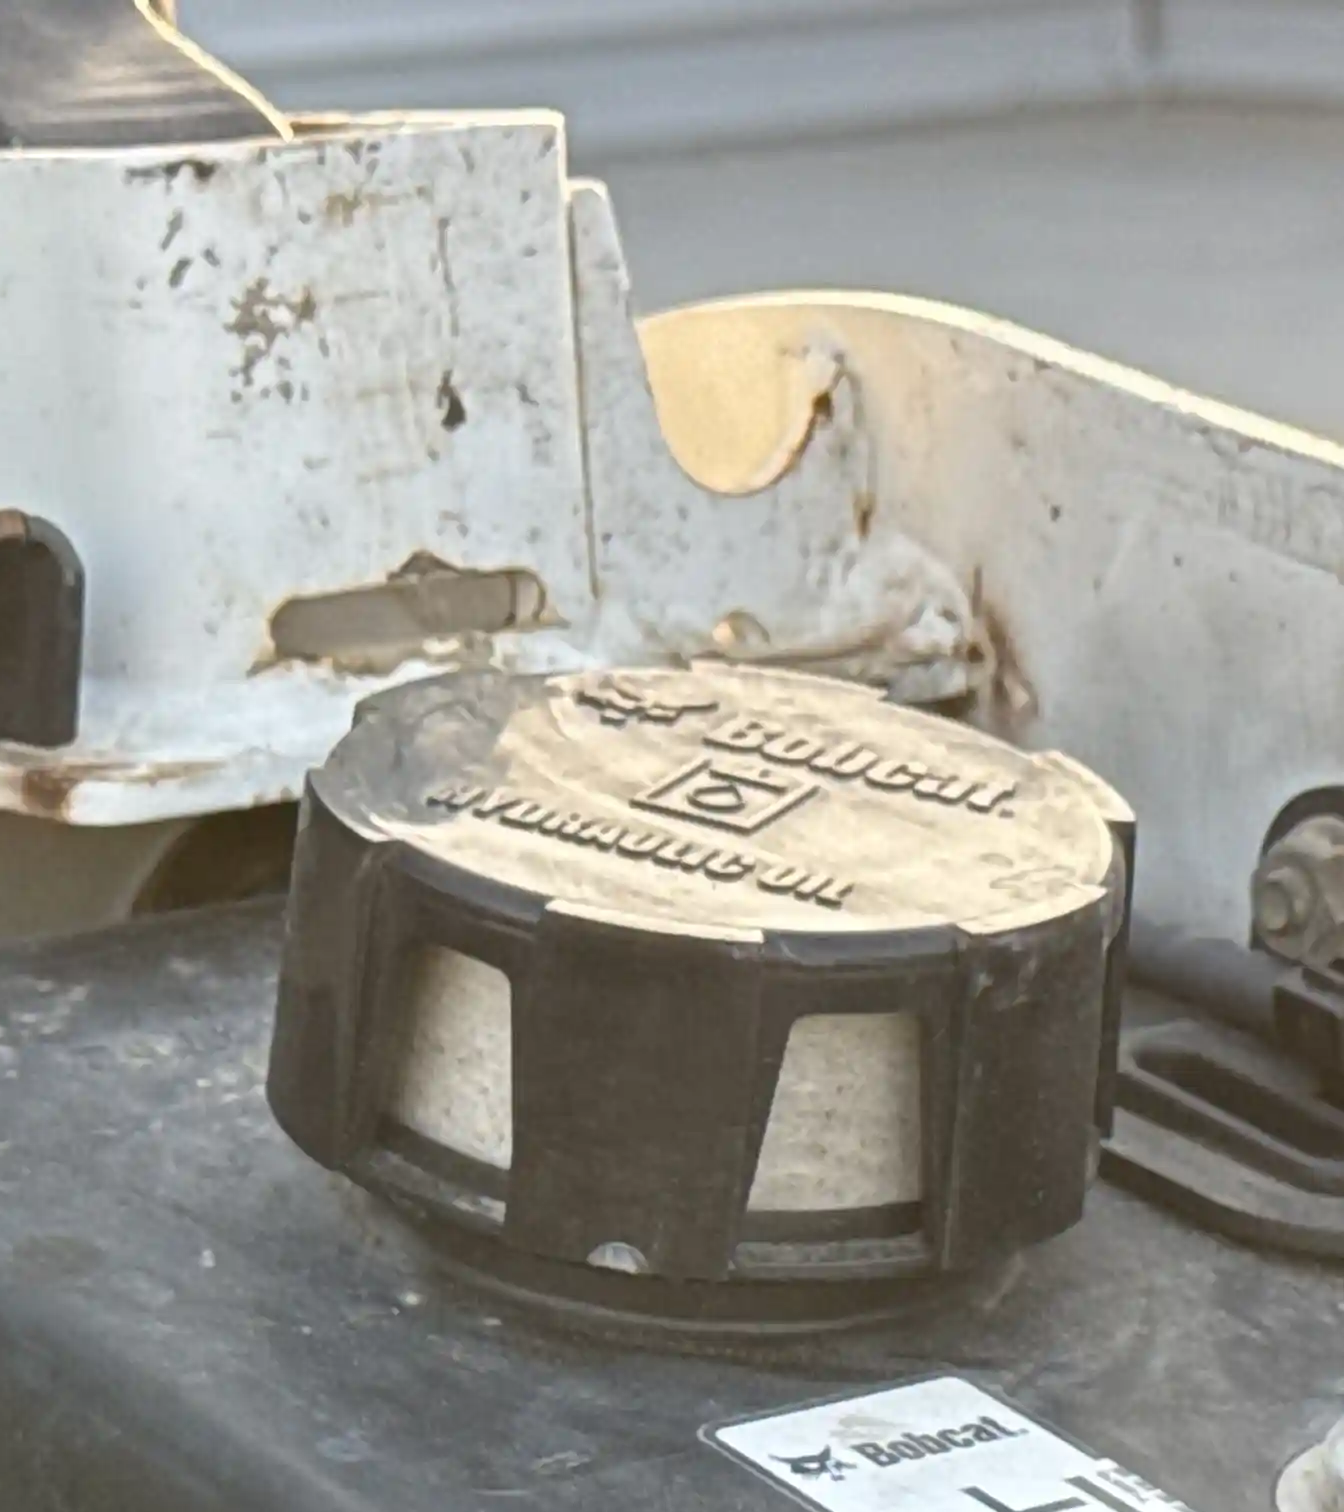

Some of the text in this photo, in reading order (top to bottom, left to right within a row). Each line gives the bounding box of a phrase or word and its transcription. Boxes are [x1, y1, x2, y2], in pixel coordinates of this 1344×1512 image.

[425, 784, 854, 905] HYDRAULIC OIL
[849, 1415, 1022, 1467] Bobcat
